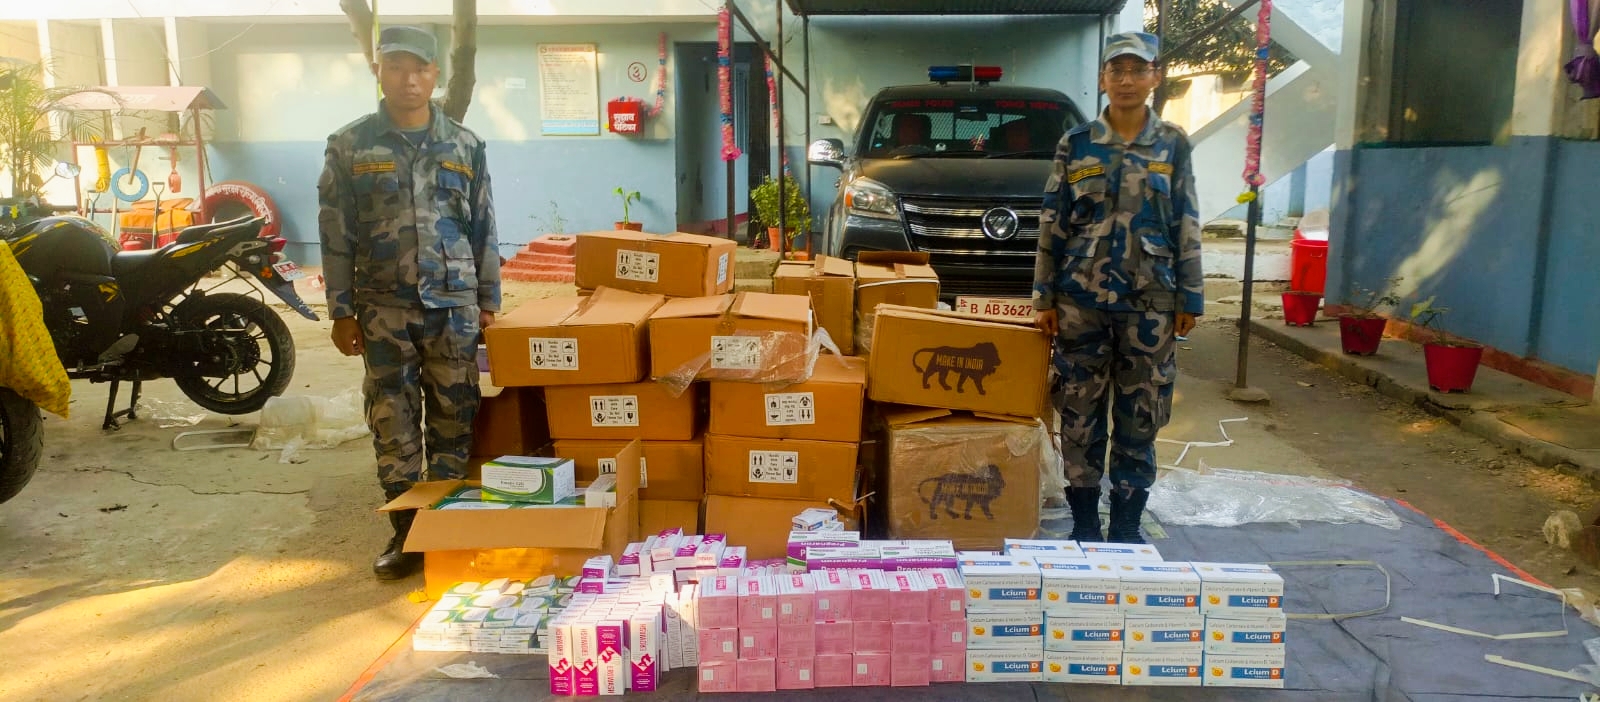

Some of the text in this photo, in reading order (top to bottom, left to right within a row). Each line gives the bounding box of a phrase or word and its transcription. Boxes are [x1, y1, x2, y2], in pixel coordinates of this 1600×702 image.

[970, 304, 1033, 316] B AB 3627
[936, 354, 984, 370] MAKE IN INDIA
[1001, 589, 1027, 597] Lcium
[1079, 593, 1105, 601] Lcium
[1164, 631, 1190, 639] Lcium
